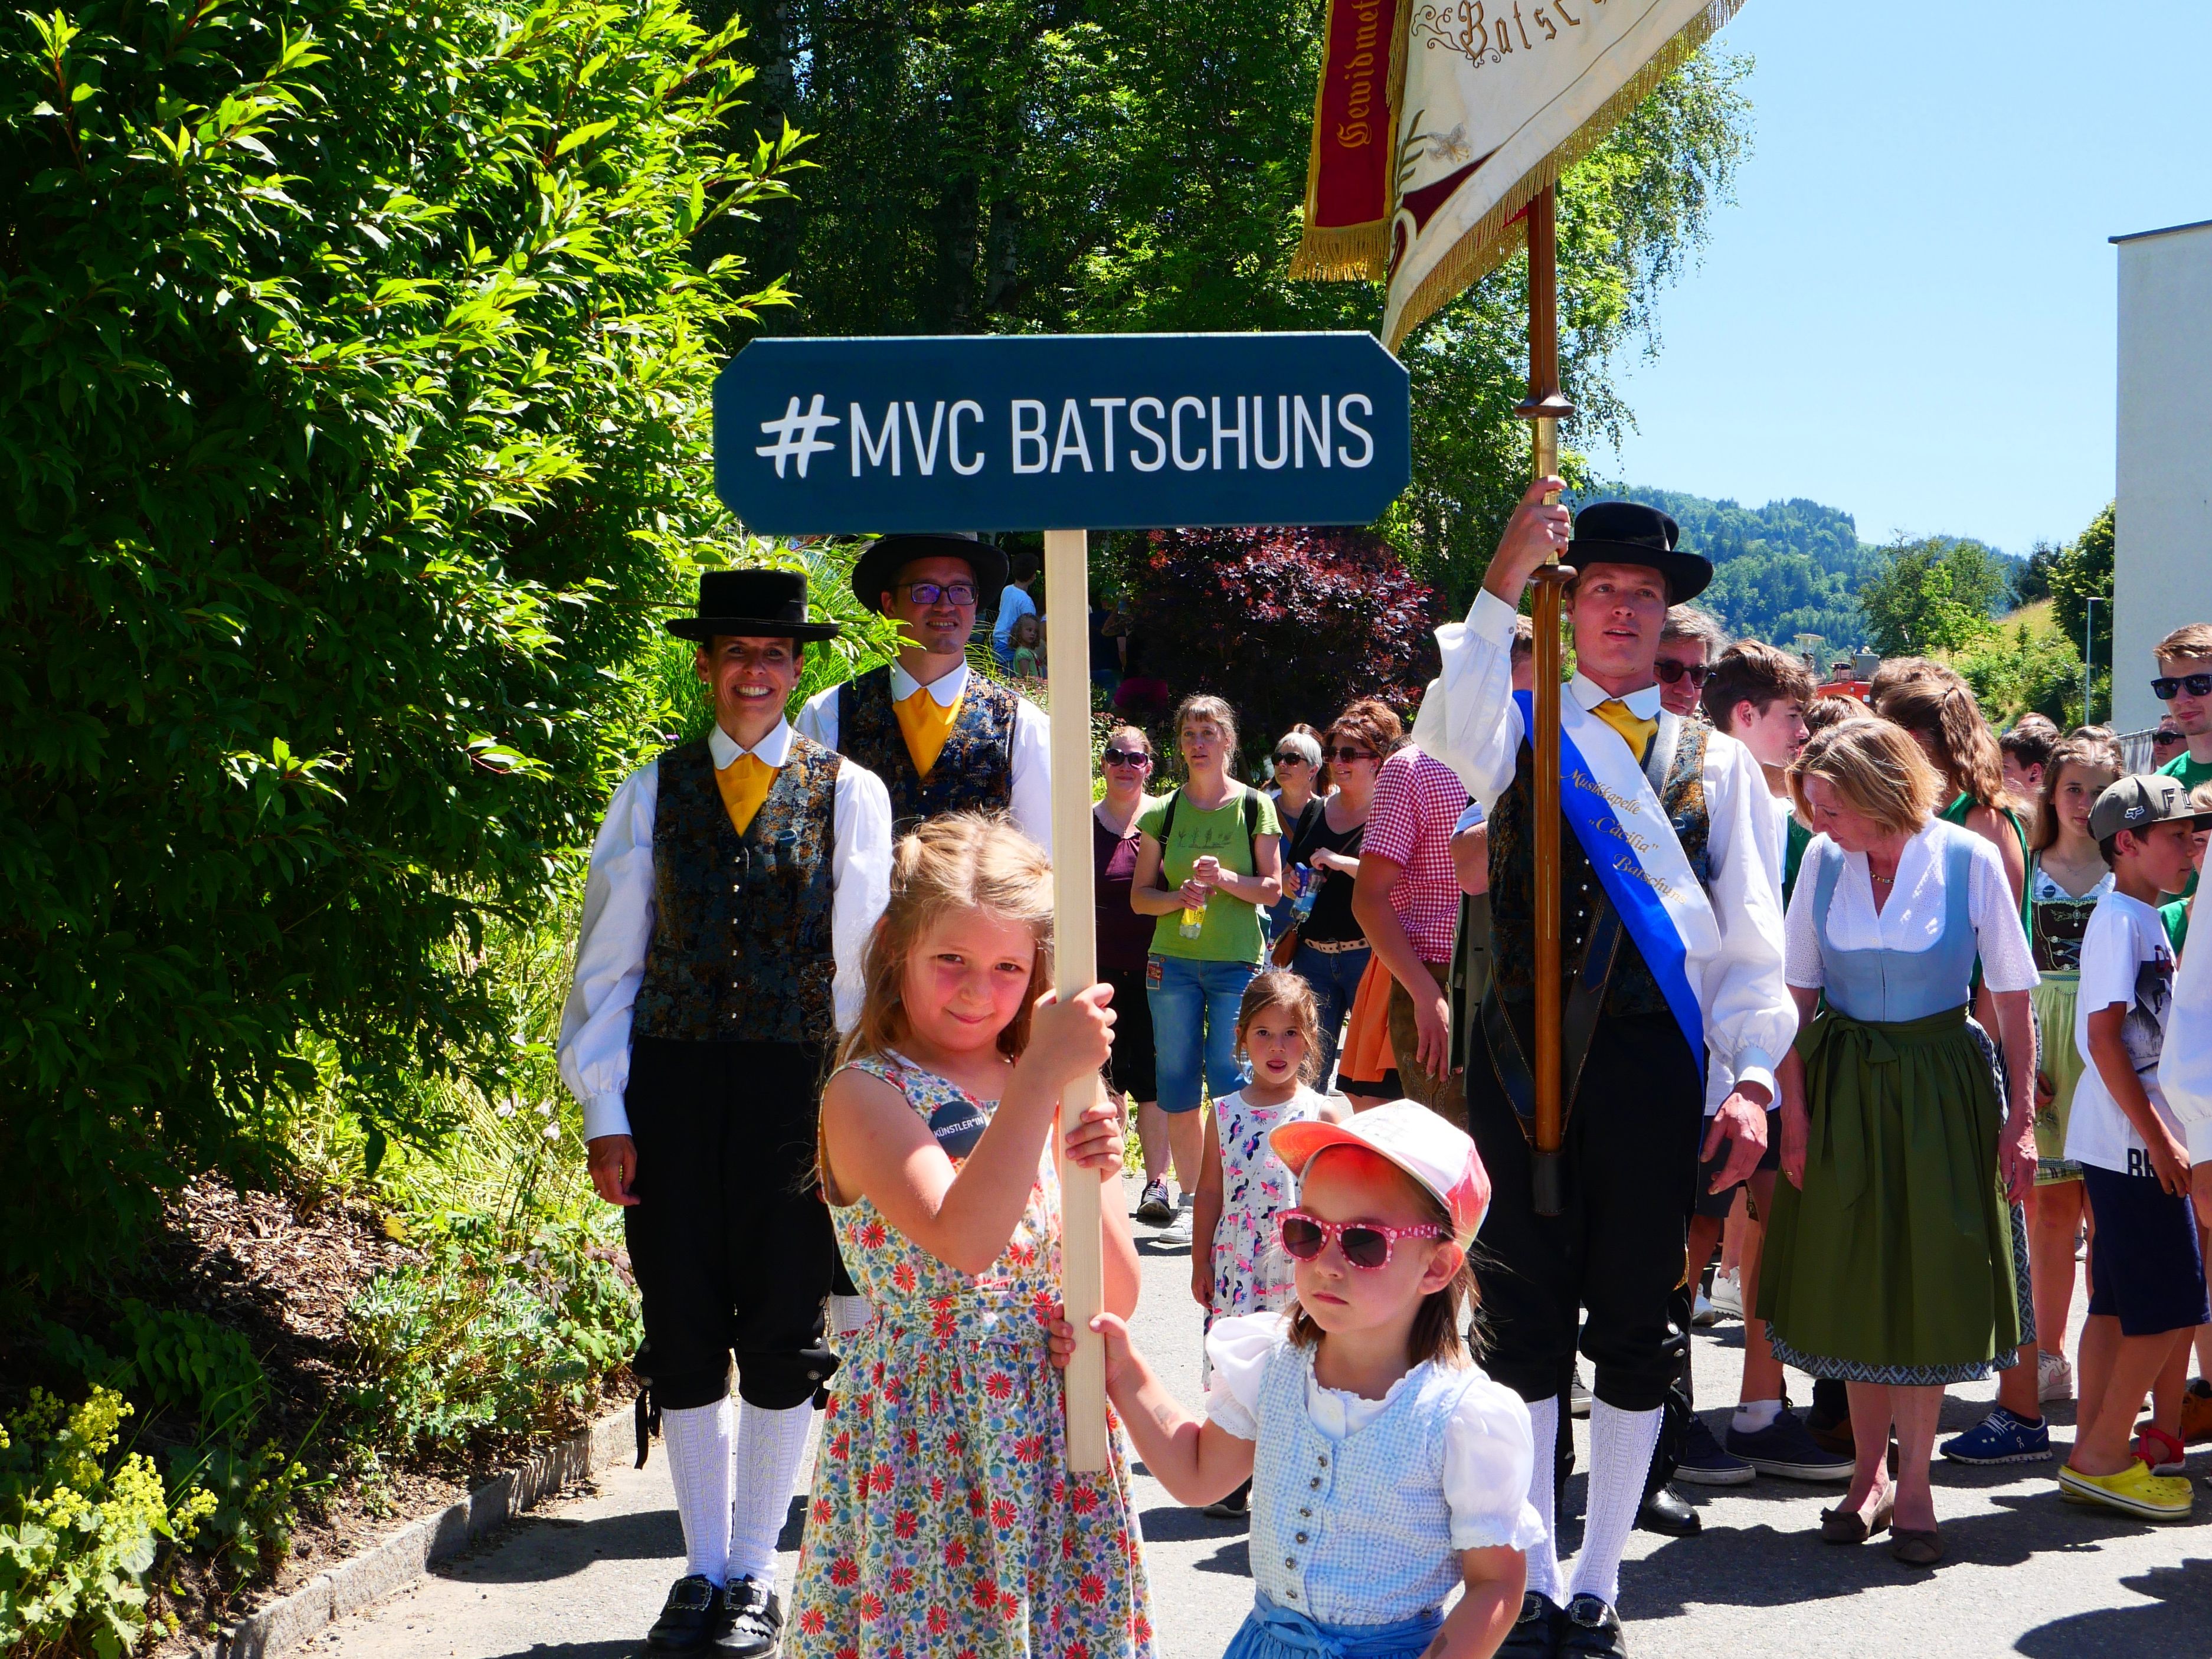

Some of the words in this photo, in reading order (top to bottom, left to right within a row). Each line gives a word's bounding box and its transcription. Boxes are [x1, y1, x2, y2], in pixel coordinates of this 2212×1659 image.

[756, 394, 984, 479] #MVC
[1012, 394, 1374, 474] BATSCHUNS
[1561, 769, 1642, 815] Musikkapelle
[1612, 853, 1687, 904] Batschuns
